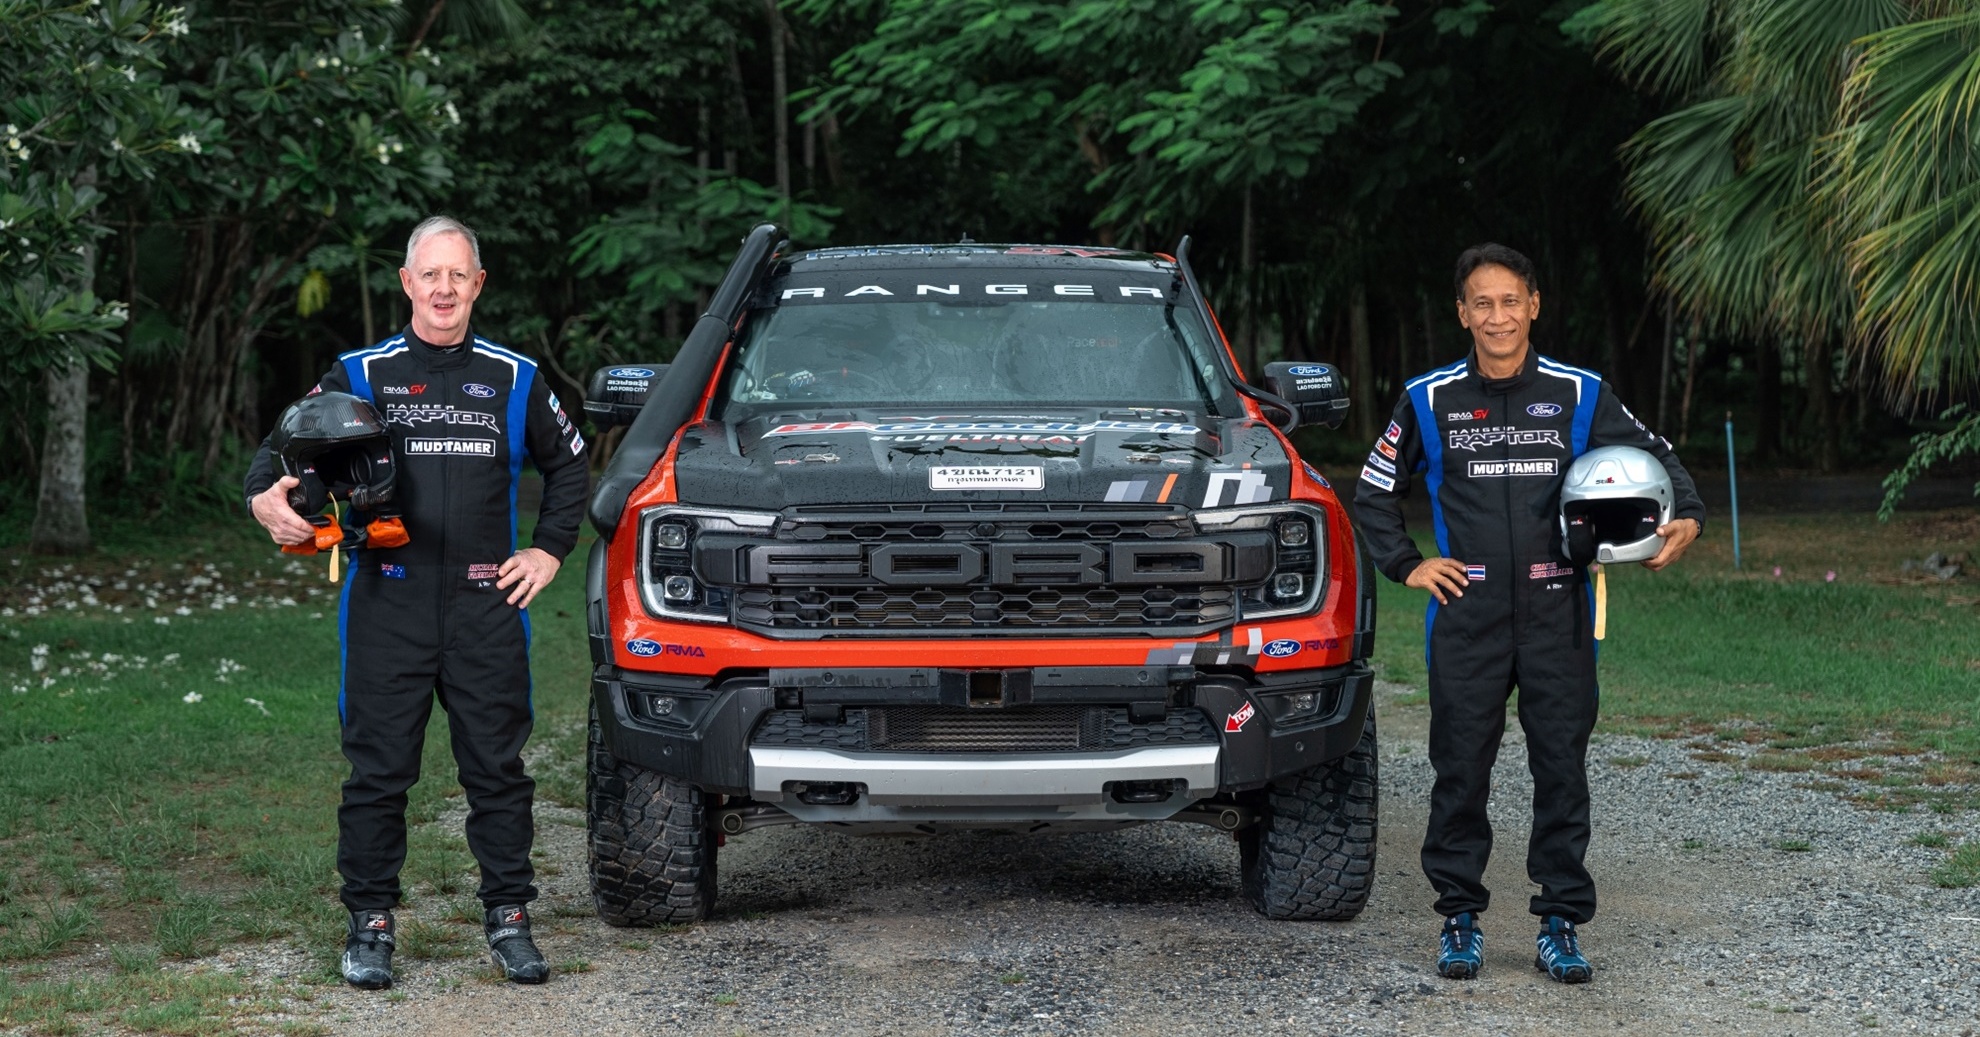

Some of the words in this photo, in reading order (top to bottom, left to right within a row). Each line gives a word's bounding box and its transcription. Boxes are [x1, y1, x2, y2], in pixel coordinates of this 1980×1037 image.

[781, 284, 1165, 300] RANGER
[383, 386, 409, 394] RMA
[409, 384, 427, 395] SV
[387, 409, 501, 434] RAPTOR
[1448, 412, 1473, 421] RMA
[1473, 409, 1489, 419] SV
[1450, 426, 1515, 435] RANGER
[1450, 430, 1565, 452] RAPTOR
[947, 477, 1024, 485] กรุงเทพมหานคร
[748, 540, 1224, 586] FORD
[666, 644, 706, 658] RMA
[1304, 639, 1339, 651] RMA
[1232, 704, 1255, 725] TOW
